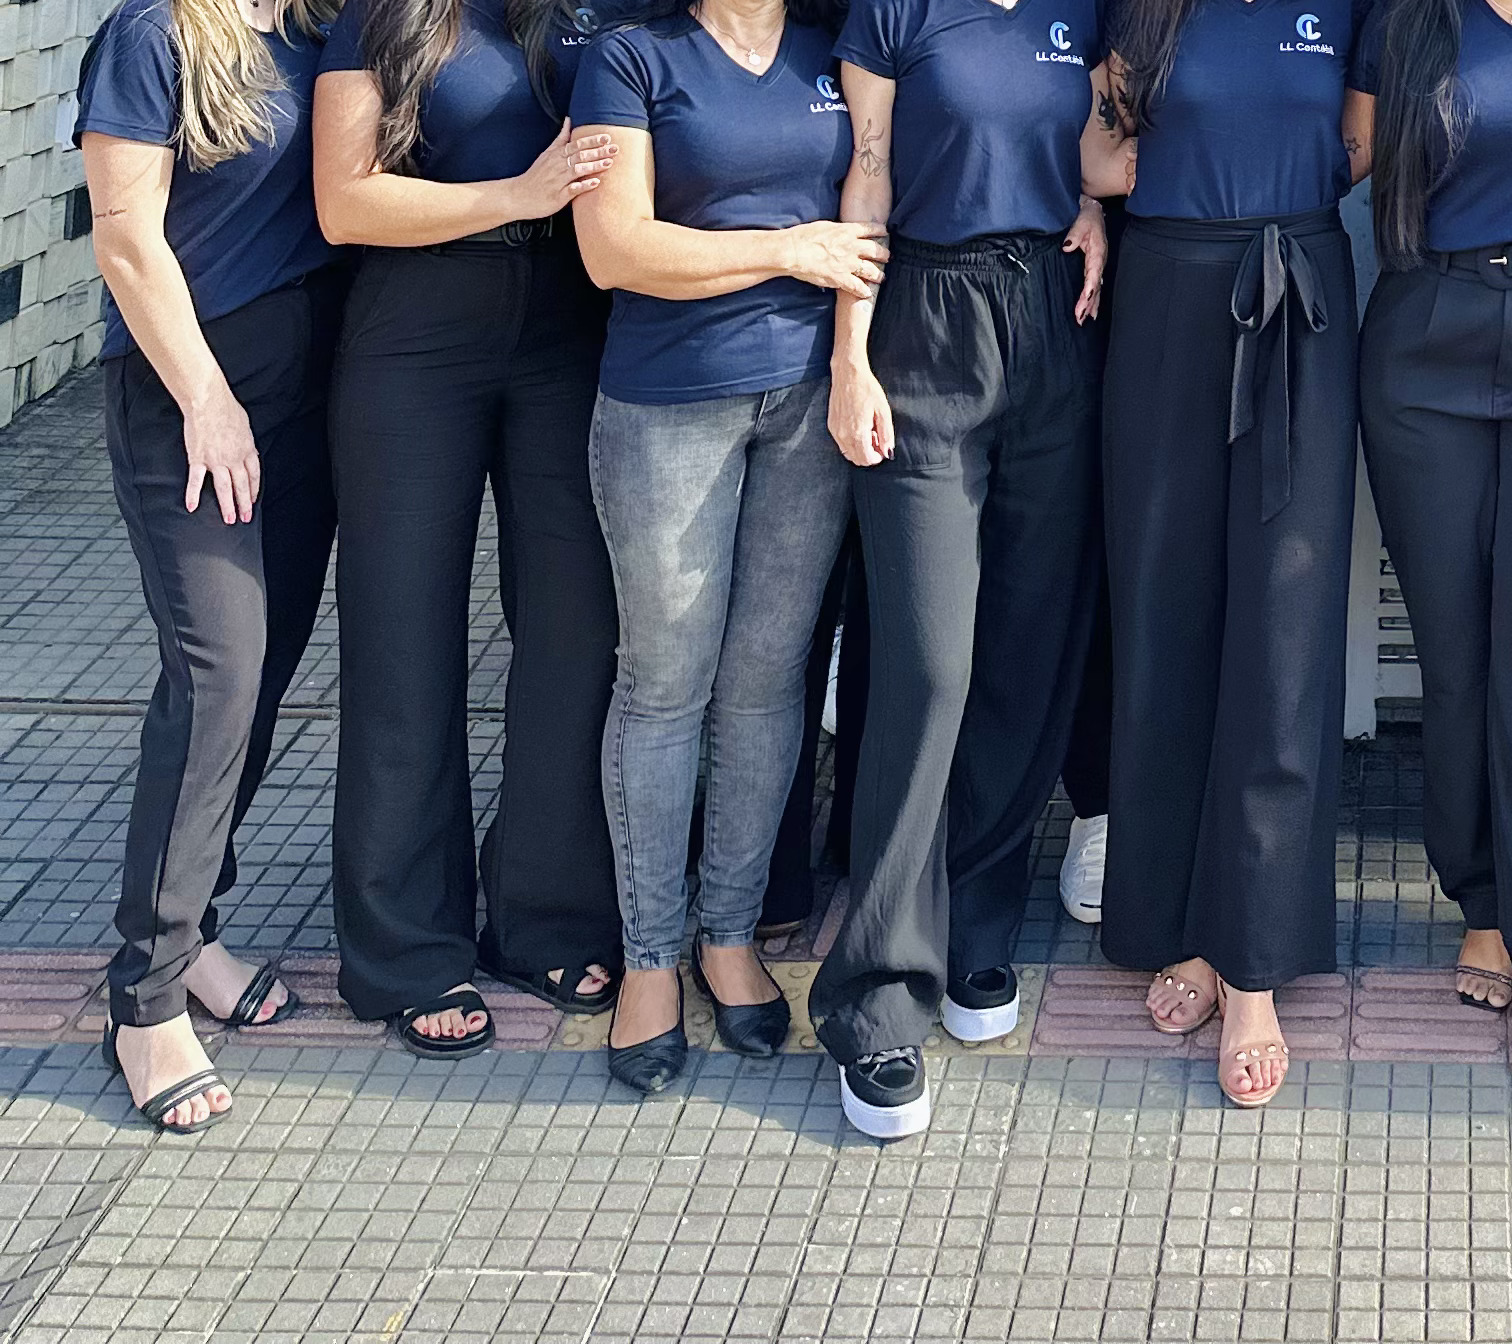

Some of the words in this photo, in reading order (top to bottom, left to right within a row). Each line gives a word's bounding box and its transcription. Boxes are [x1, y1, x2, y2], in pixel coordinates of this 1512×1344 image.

[1279, 42, 1295, 52] LL
[1035, 51, 1050, 62] LL
[810, 102, 825, 113] LL
